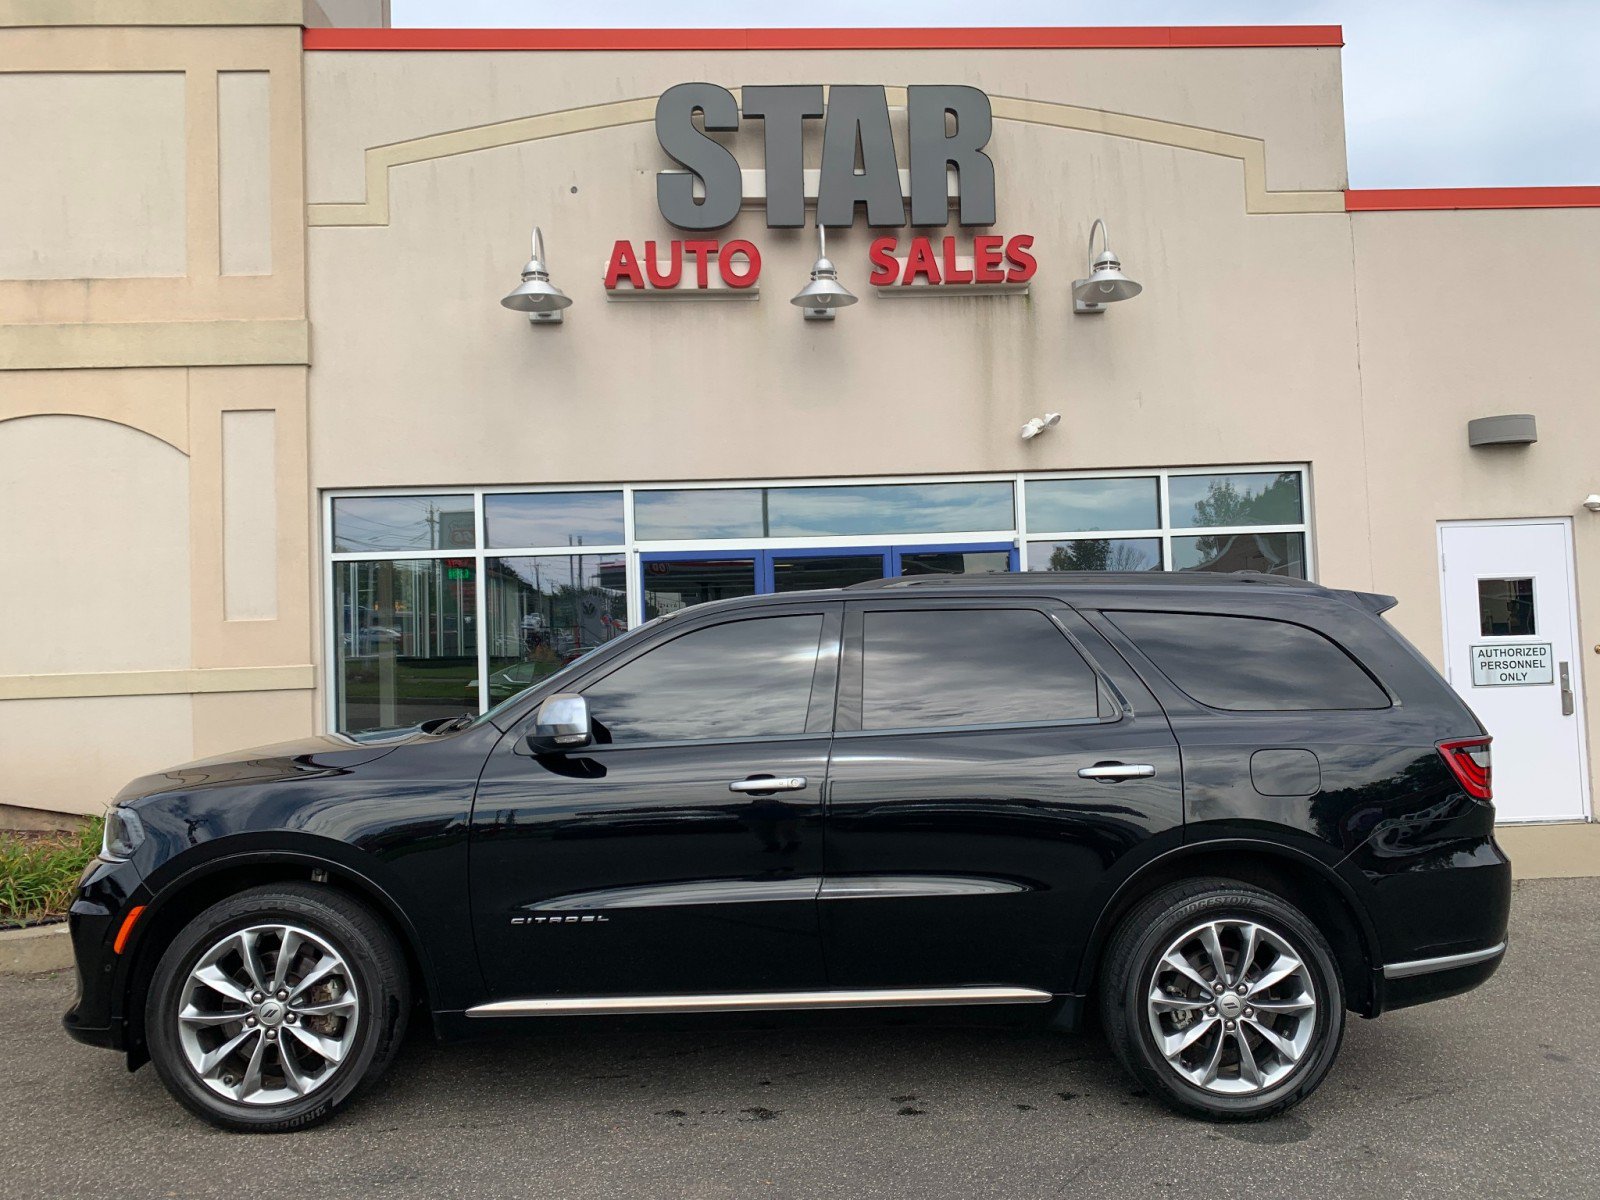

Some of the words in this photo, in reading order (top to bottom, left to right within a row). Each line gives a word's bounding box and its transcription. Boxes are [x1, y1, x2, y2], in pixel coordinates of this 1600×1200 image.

[655, 82, 996, 231] STAR
[604, 239, 761, 289] AUTO
[868, 234, 1037, 286] SALES
[1477, 647, 1547, 659] AUTHORIZED
[1480, 659, 1546, 670] PERSONNEL
[1499, 672, 1528, 682] ONLY
[510, 915, 610, 924] CITADEL
